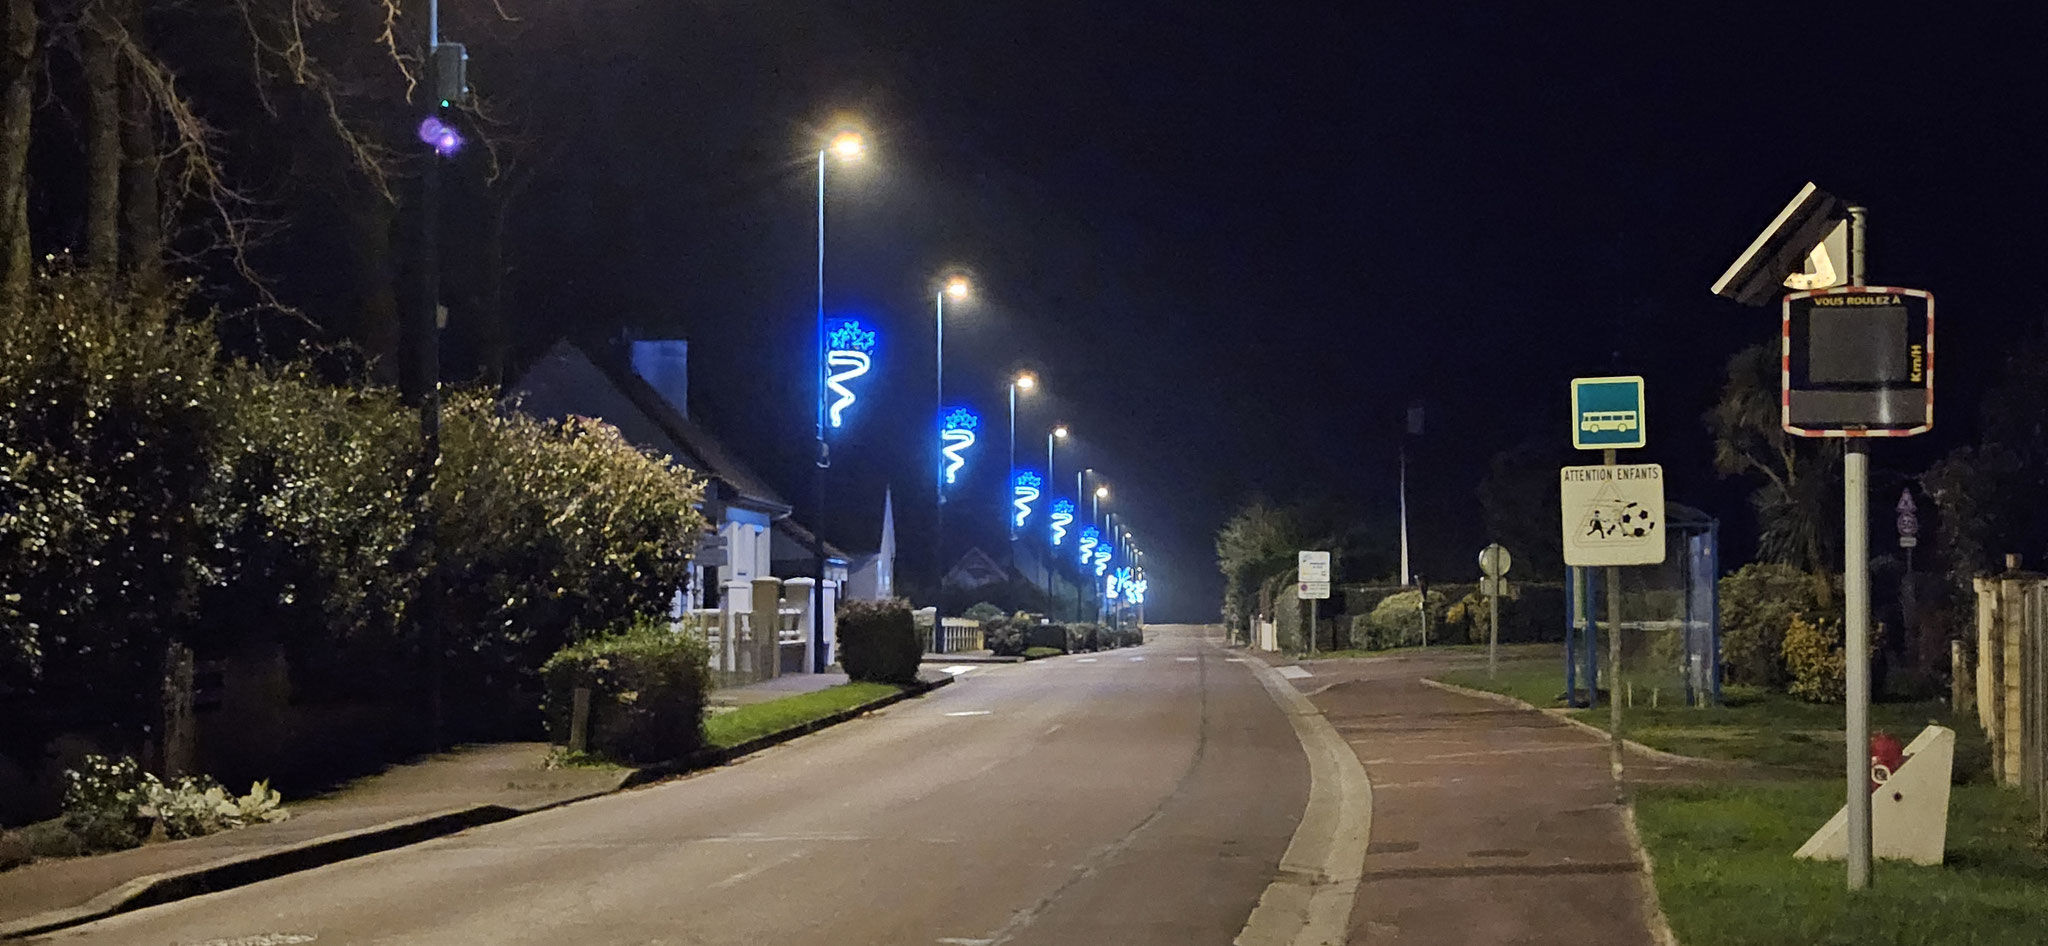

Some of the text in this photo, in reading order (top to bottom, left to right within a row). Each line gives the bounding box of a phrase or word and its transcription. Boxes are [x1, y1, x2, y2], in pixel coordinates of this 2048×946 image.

[1814, 297, 1844, 306] VOUS
[1847, 296, 1890, 305] ROULEZ
[1910, 344, 1922, 382] Km/H
[1564, 467, 1659, 481] ATTENTION ENFANTS
